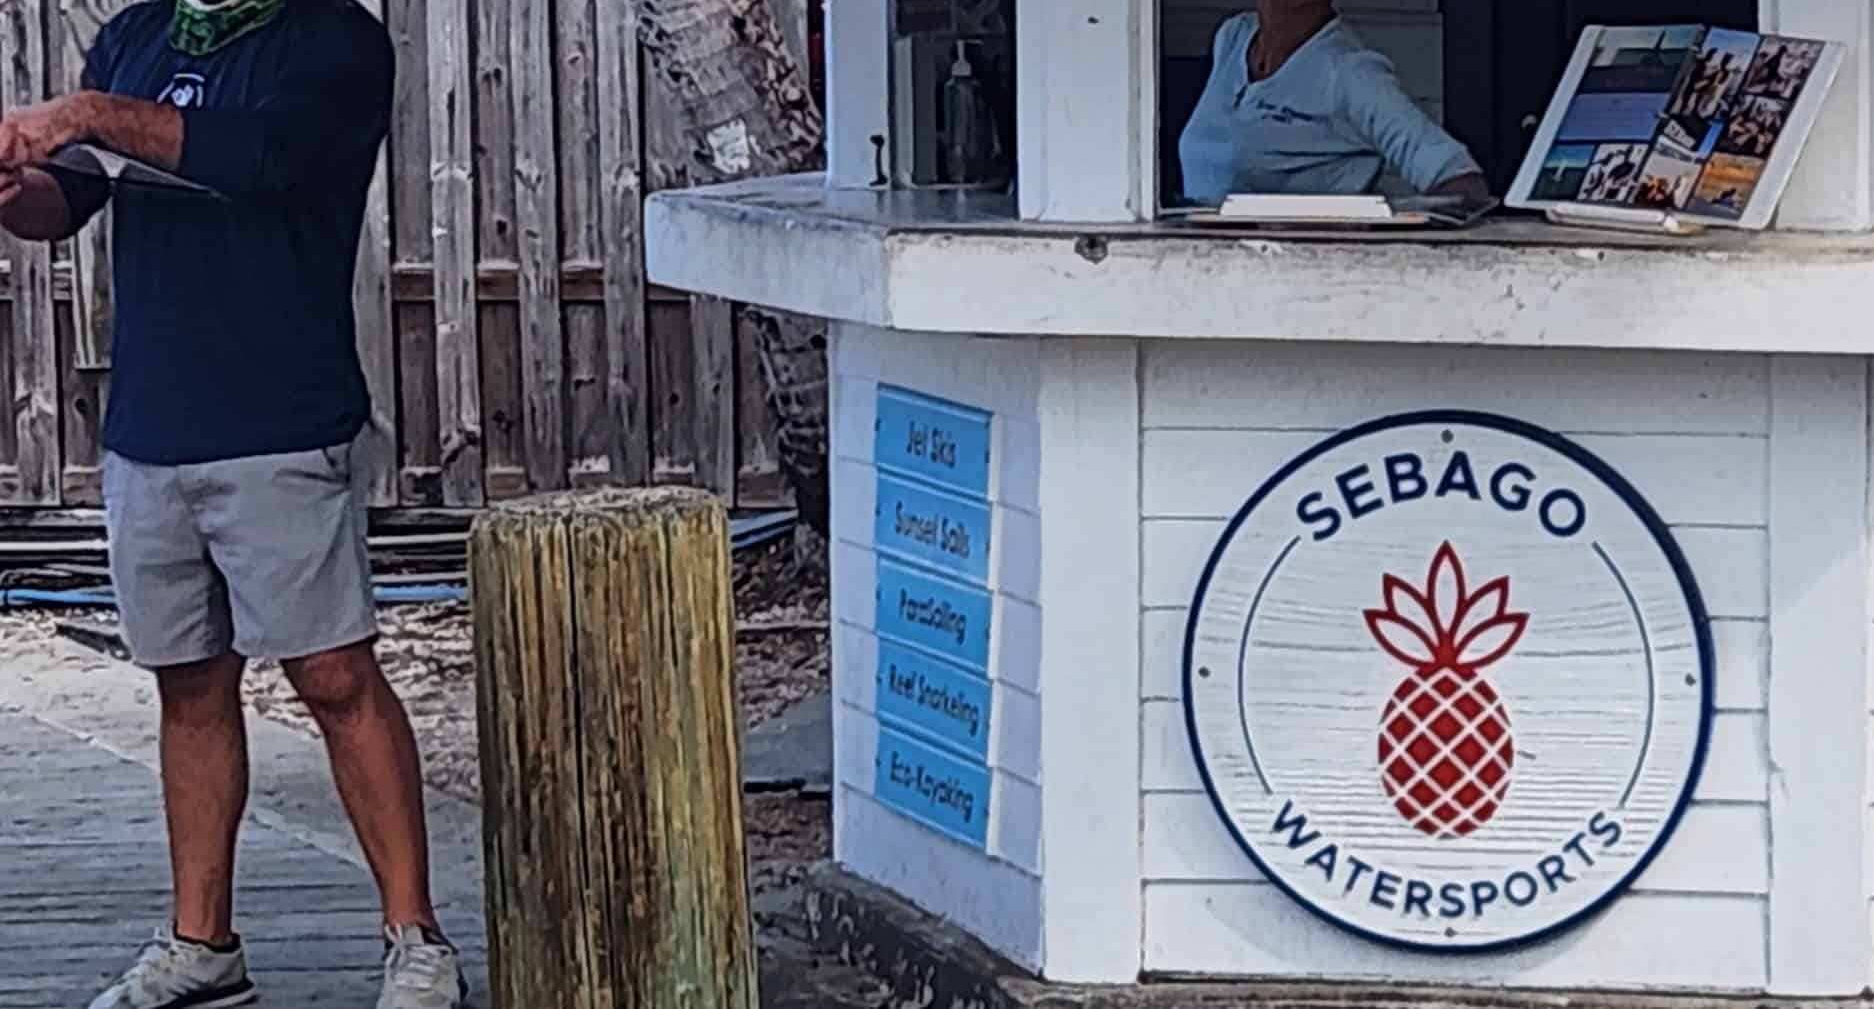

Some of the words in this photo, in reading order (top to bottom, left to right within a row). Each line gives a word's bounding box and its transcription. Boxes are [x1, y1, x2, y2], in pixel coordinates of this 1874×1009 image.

[905, 421, 927, 458] Jet
[930, 427, 957, 470] Skis
[894, 502, 938, 548] Sunset
[940, 517, 970, 560] Sails
[1296, 450, 1586, 541] SEBAGO
[899, 588, 967, 645] ParaSailing
[888, 662, 915, 699] Reef
[918, 674, 979, 737] Snorkeling
[890, 750, 974, 823] Eco-Kayaking
[1272, 799, 1622, 918] WATERSPORTS
